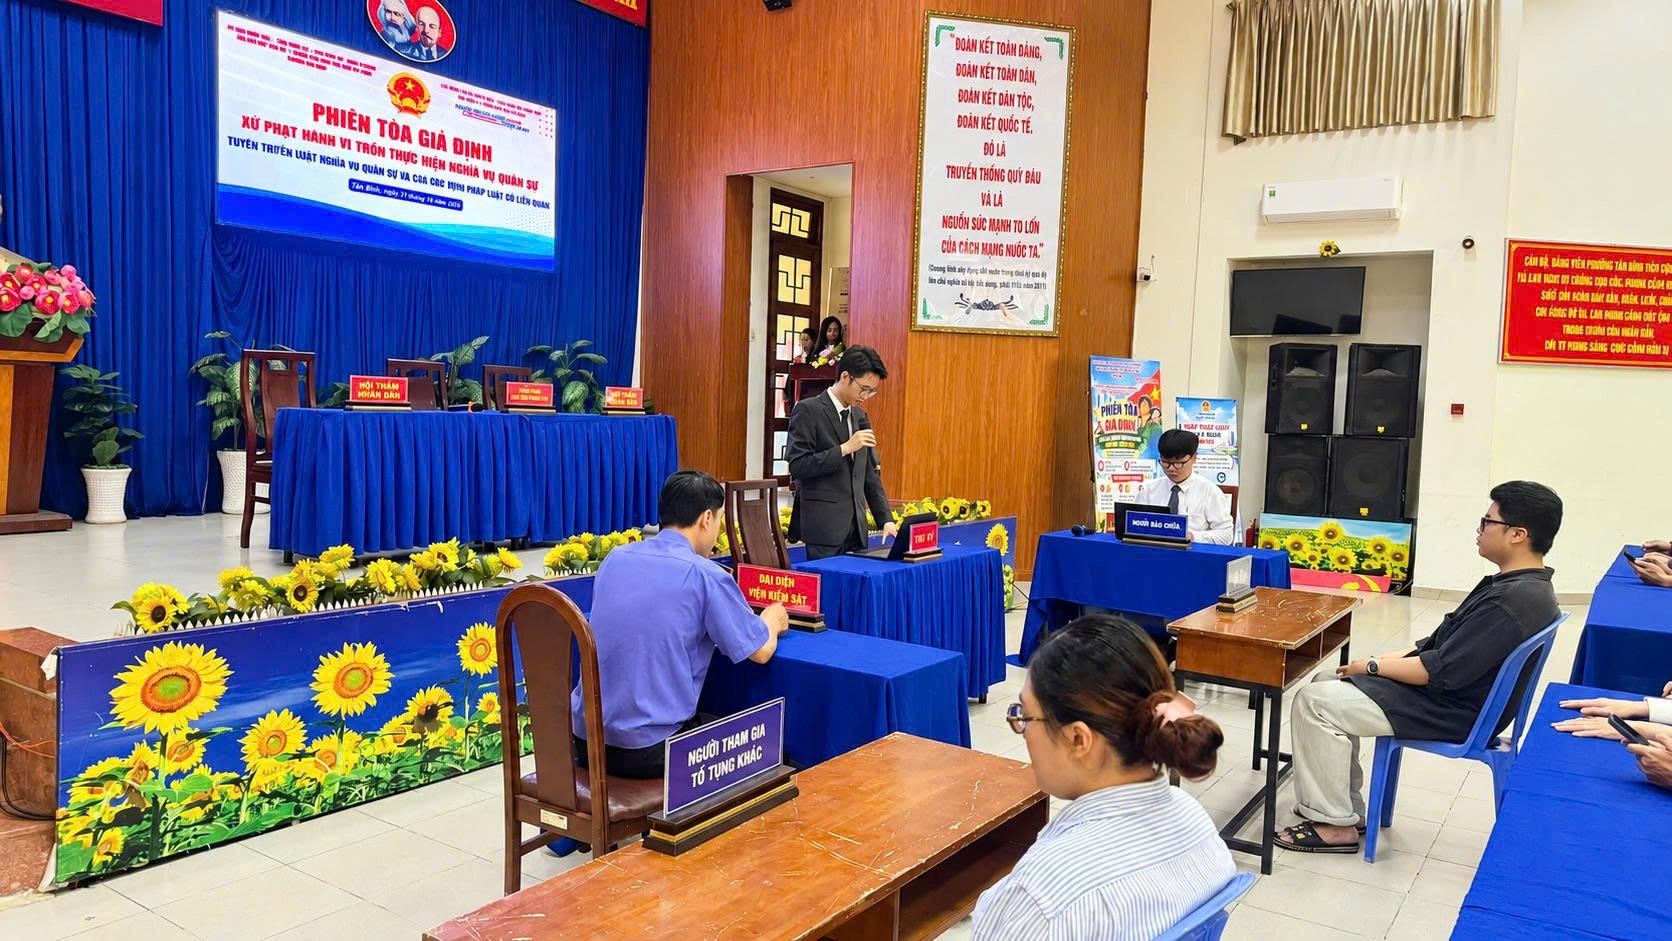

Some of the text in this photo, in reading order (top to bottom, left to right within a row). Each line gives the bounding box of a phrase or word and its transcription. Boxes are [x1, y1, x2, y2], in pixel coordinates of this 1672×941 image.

[979, 35, 994, 54] KẾT
[980, 62, 996, 80] KẾT
[981, 88, 998, 106] KẾT
[312, 102, 370, 134] PHIÊN
[377, 118, 412, 144] TÒA
[453, 137, 492, 162] ĐỊNH
[981, 113, 997, 131] KẾT
[998, 114, 1019, 134] QUỐC
[264, 120, 298, 139] PHẠT
[302, 128, 336, 147] HÀNH
[340, 137, 351, 150] VI
[389, 147, 418, 165] THỰC
[421, 155, 445, 172] HIỆN
[483, 169, 495, 184] VỤ
[988, 219, 1012, 236] MẠNH
[1013, 220, 1023, 234] TO
[688, 723, 766, 767] NGƯỜI THAM GIA
[691, 745, 762, 788] TỐ TỤNG KHÁC
